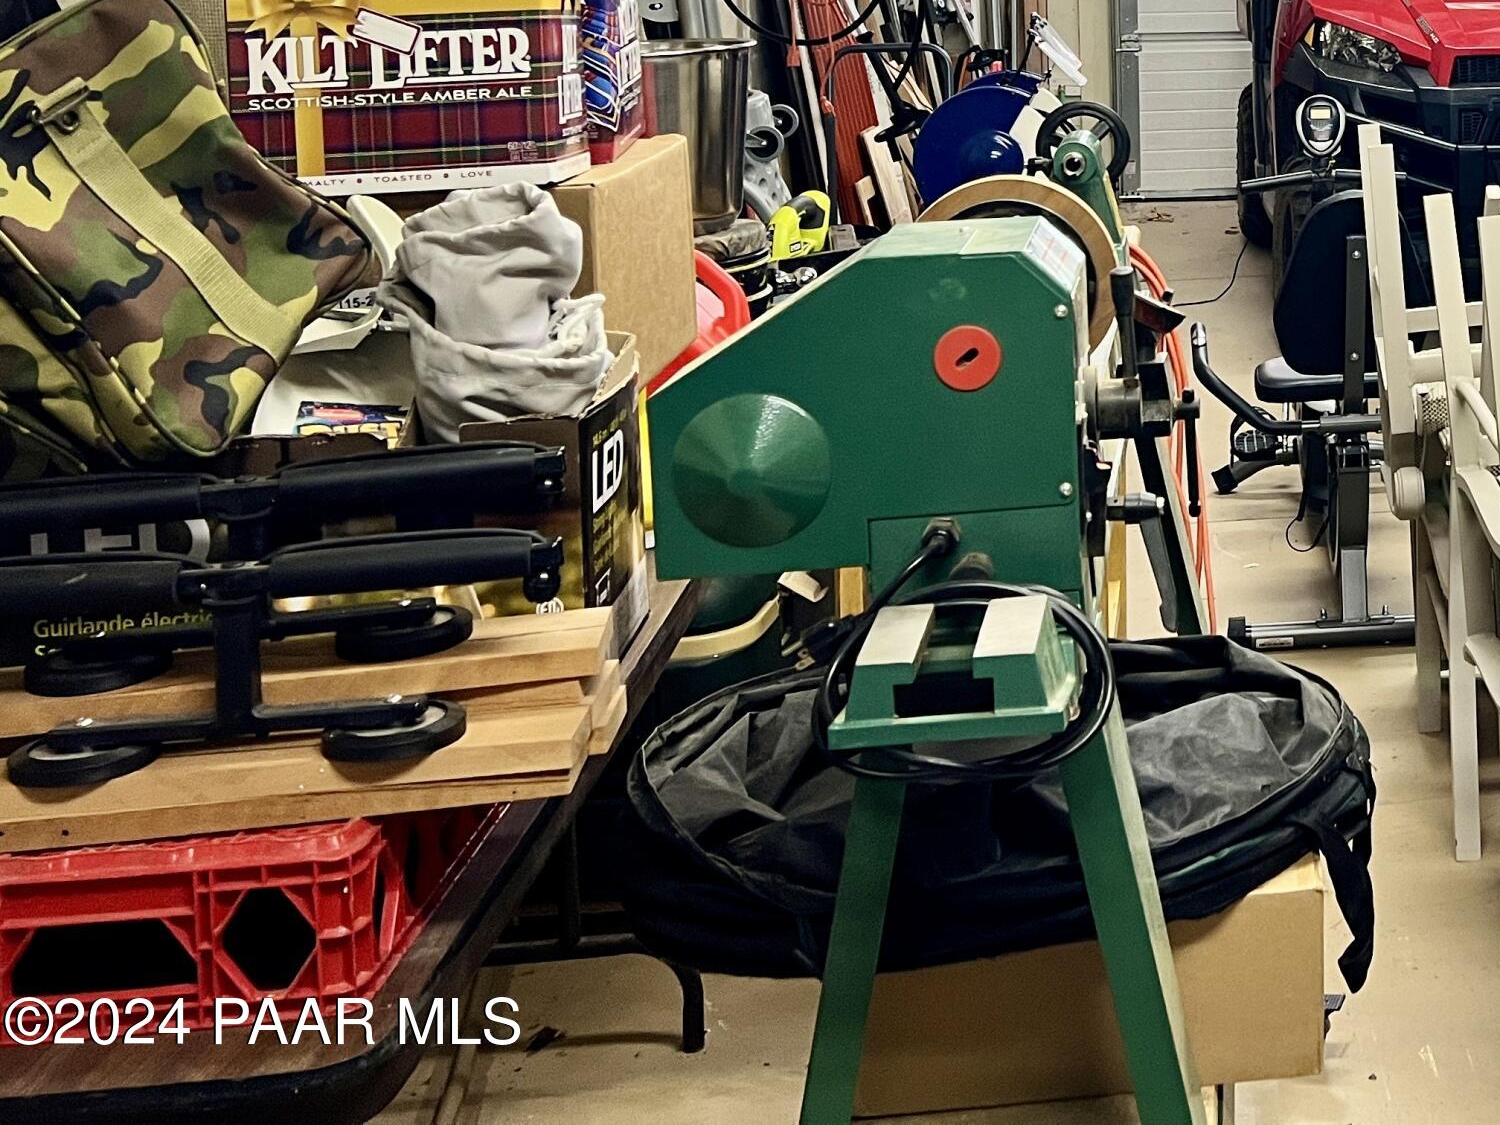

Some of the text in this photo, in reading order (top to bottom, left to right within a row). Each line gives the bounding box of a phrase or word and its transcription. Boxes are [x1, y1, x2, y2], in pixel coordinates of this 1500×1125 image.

[245, 34, 358, 95] KILT
[248, 86, 532, 111] SCOTTISH-STYLE AMBER ALE
[374, 174, 433, 183] TOASTED
[460, 170, 493, 178] LOVE
[592, 429, 624, 514] LED
[33, 614, 135, 638] Guirlande
